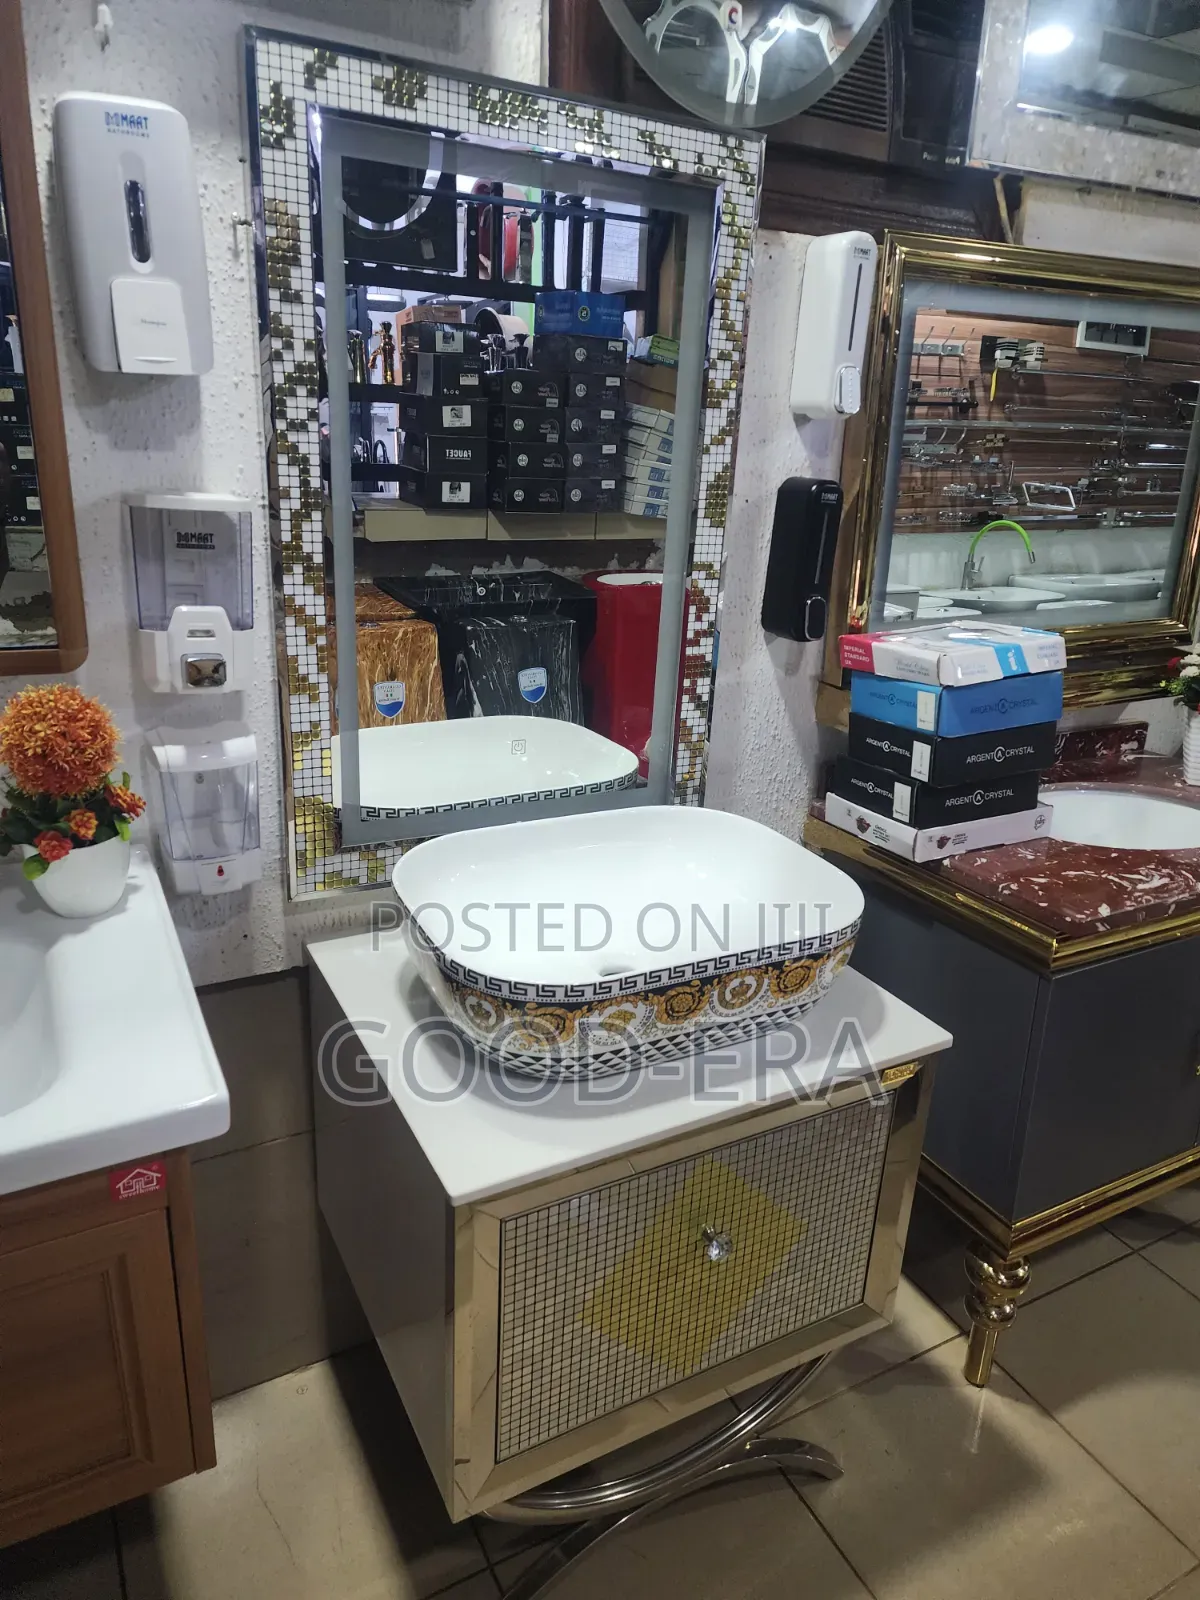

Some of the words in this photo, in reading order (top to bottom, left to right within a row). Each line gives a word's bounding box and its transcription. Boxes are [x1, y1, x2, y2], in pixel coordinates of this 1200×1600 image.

[843, 644, 866, 655] IMPERIAL
[844, 651, 870, 663] STANDARD
[970, 703, 998, 715] ARGENT
[1008, 699, 1039, 710] CRYSTAL
[866, 737, 883, 748] ARGENT
[890, 745, 911, 758] CRYSTAL
[966, 751, 995, 764] ARGENT
[1005, 745, 1035, 757] CRYSTAL
[850, 777, 868, 789] ARGENT
[874, 786, 894, 800] CRYSTAL
[944, 795, 973, 807] ARGENT
[984, 788, 1014, 800] CRYSTAL
